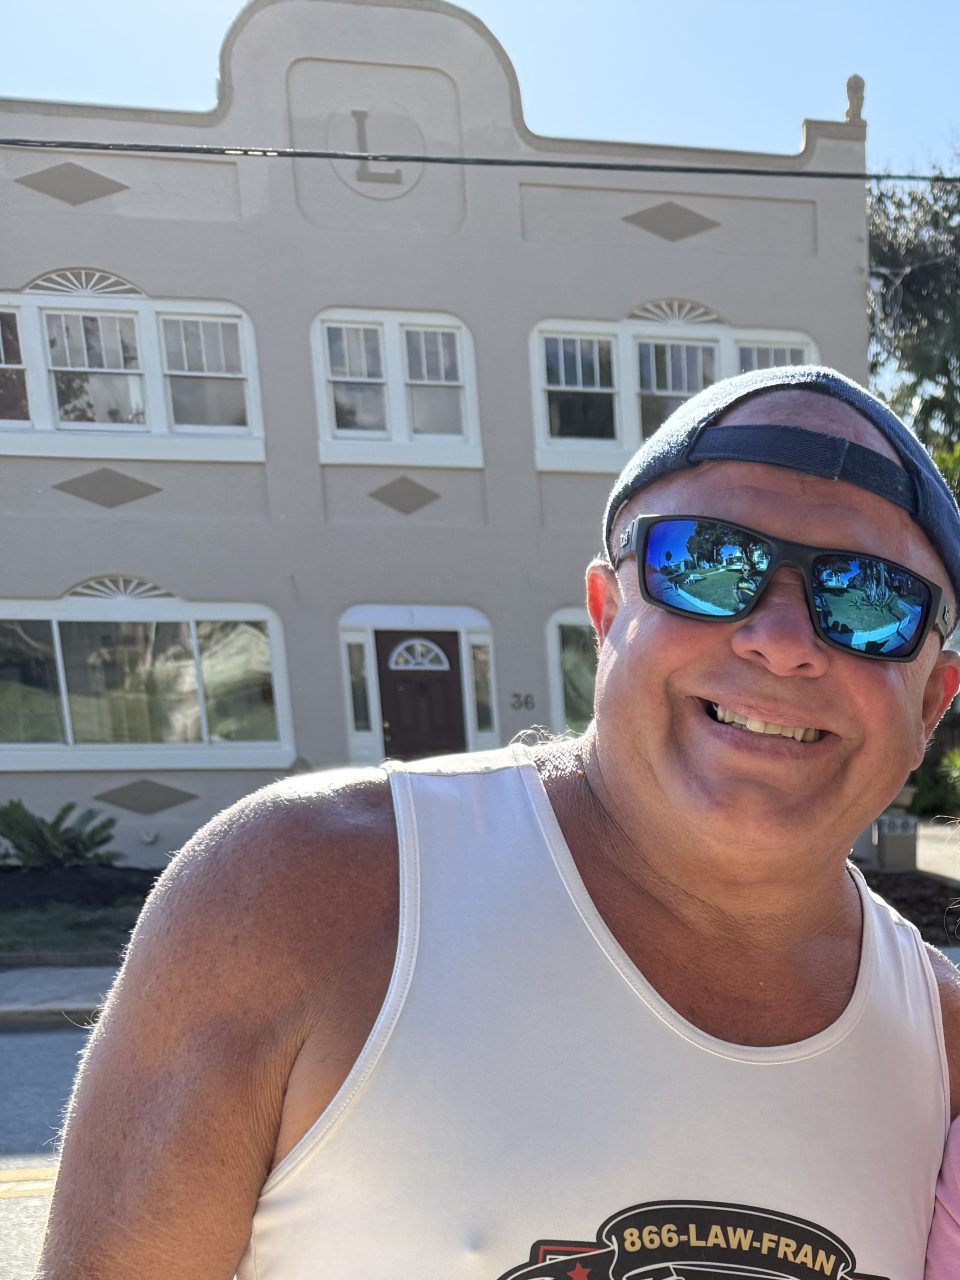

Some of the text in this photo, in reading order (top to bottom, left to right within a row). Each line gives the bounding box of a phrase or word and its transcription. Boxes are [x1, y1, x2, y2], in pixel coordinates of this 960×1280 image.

[351, 109, 403, 185] L
[510, 693, 536, 711] 36
[623, 1223, 837, 1276] 866-LAW-FRAN
